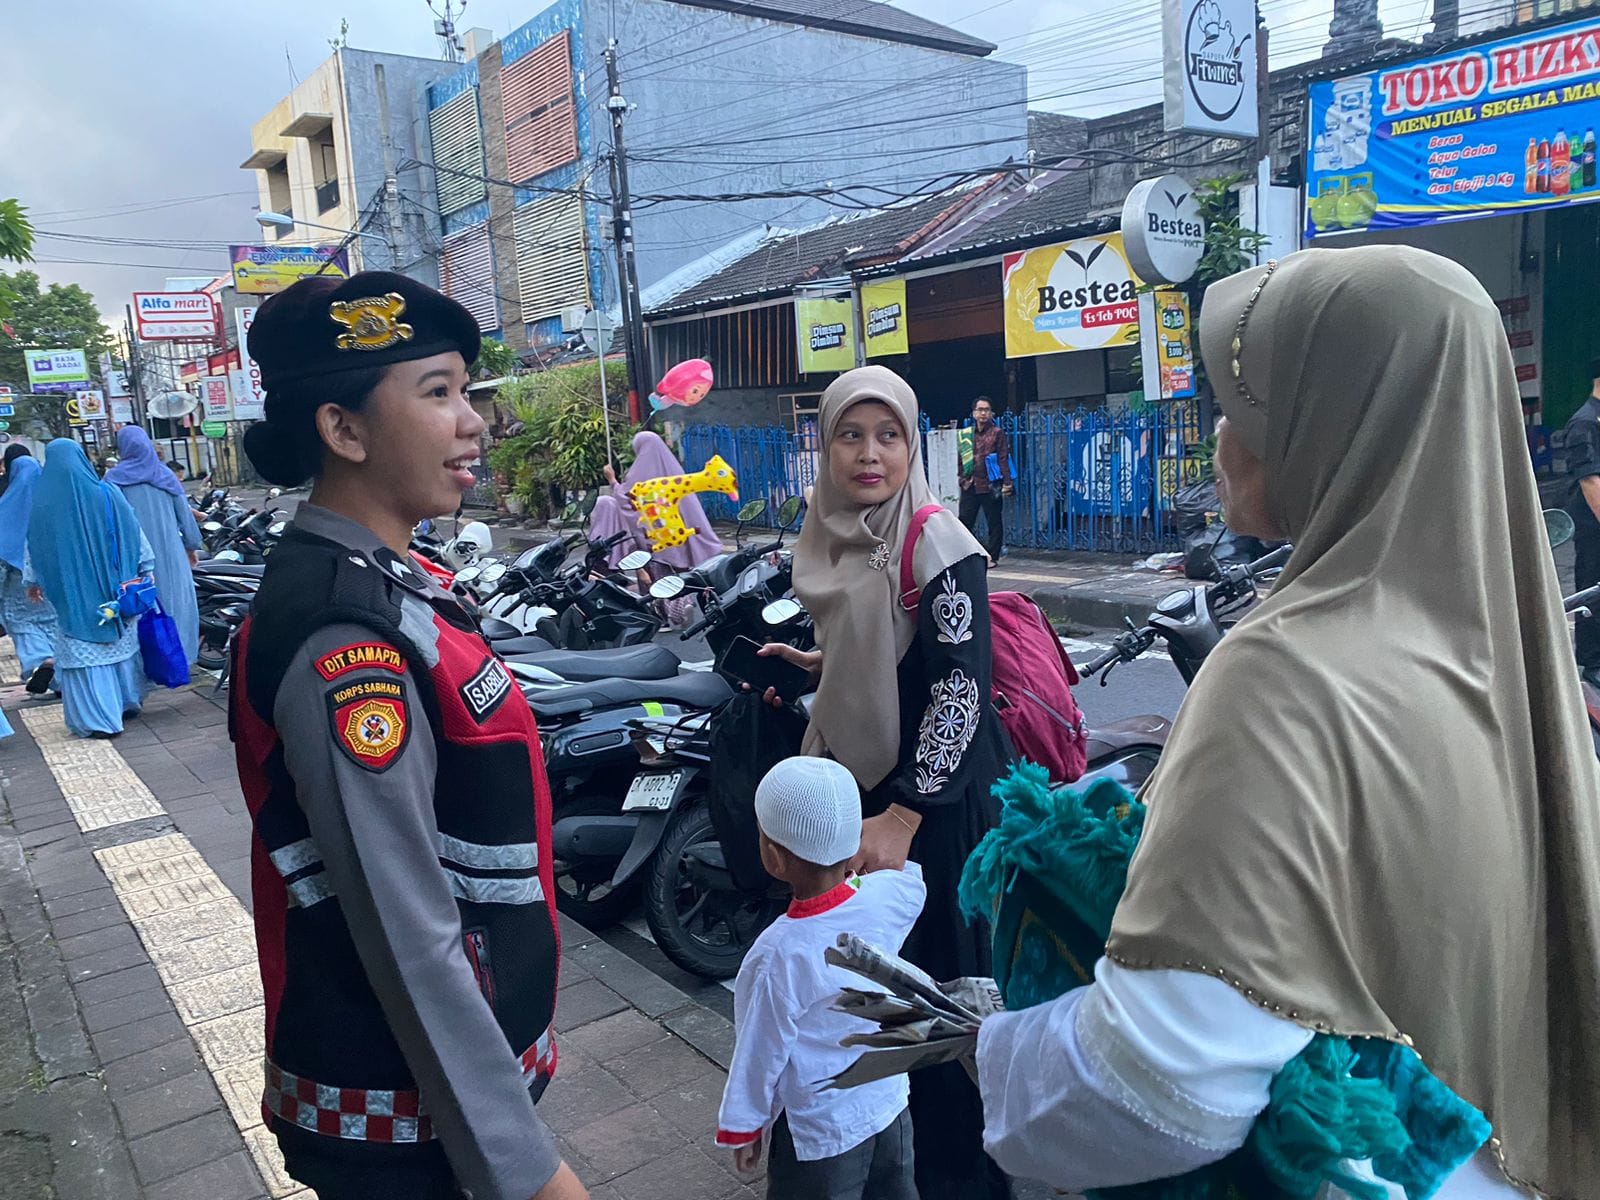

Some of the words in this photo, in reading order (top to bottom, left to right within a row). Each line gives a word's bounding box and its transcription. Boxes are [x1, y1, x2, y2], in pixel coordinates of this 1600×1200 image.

[1200, 60, 1236, 83] twins
[1383, 56, 1483, 112] TOKO
[1391, 109, 1476, 136] MENJUAL
[1481, 90, 1559, 119] SEGALA
[1429, 134, 1463, 149] Beras
[1428, 151, 1460, 165] Aqua
[1461, 144, 1497, 158] Galon
[1428, 184, 1452, 194] Gas
[1453, 175, 1486, 193] Elpiji
[1486, 174, 1495, 186] 3
[1496, 172, 1515, 186] Kg
[1429, 166, 1458, 179] Telur
[1147, 212, 1201, 238] Bestea
[141, 297, 171, 309] Alfa
[174, 298, 208, 309] mart
[1037, 279, 1138, 313] Bestea
[1113, 306, 1138, 319] POC
[324, 653, 346, 673] DIT
[347, 646, 401, 667] SAMAPTA
[333, 684, 364, 703] KORPS
[364, 682, 401, 696] SABHARA
